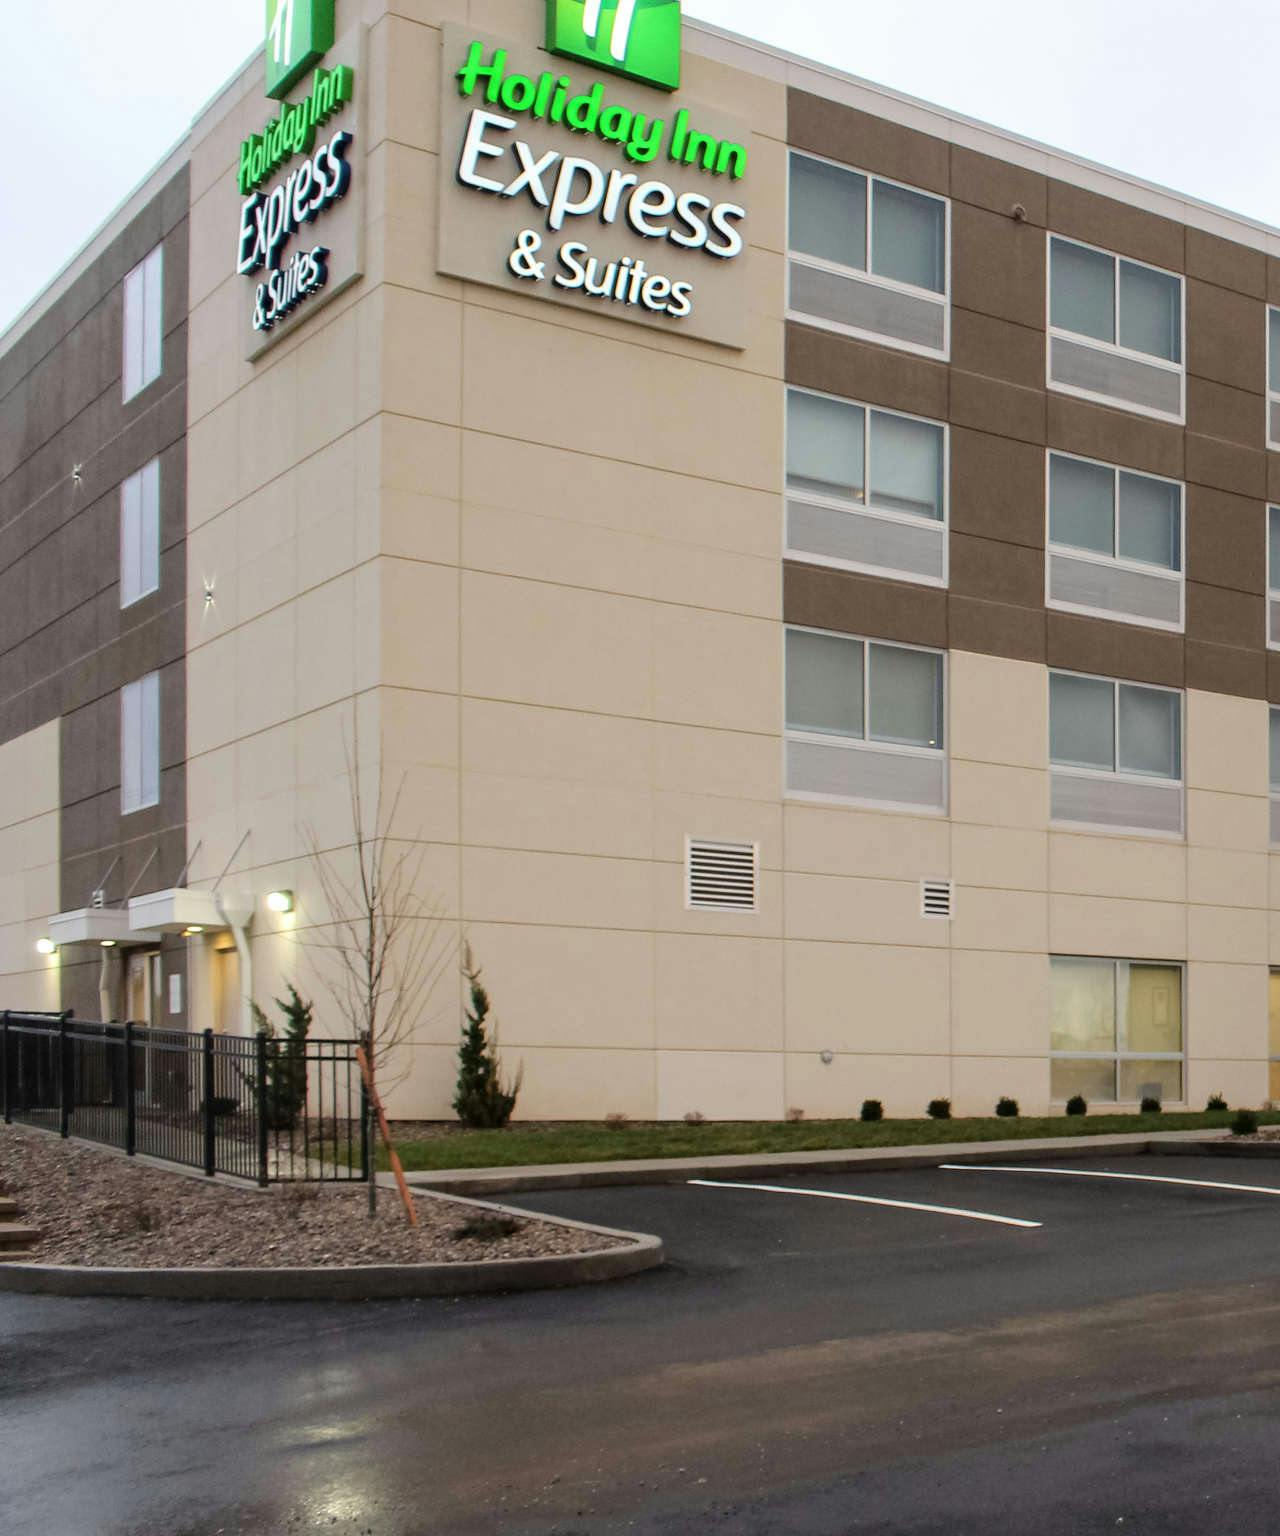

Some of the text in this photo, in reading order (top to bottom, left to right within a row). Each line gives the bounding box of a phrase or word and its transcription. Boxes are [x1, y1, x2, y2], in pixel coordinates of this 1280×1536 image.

[237, 64, 347, 195] Holiday Inn
[456, 40, 748, 179] Holiday Inn
[236, 130, 347, 275] Express
[457, 108, 746, 259] Express
[253, 246, 323, 330] & Suites
[507, 229, 694, 318] & Suites
